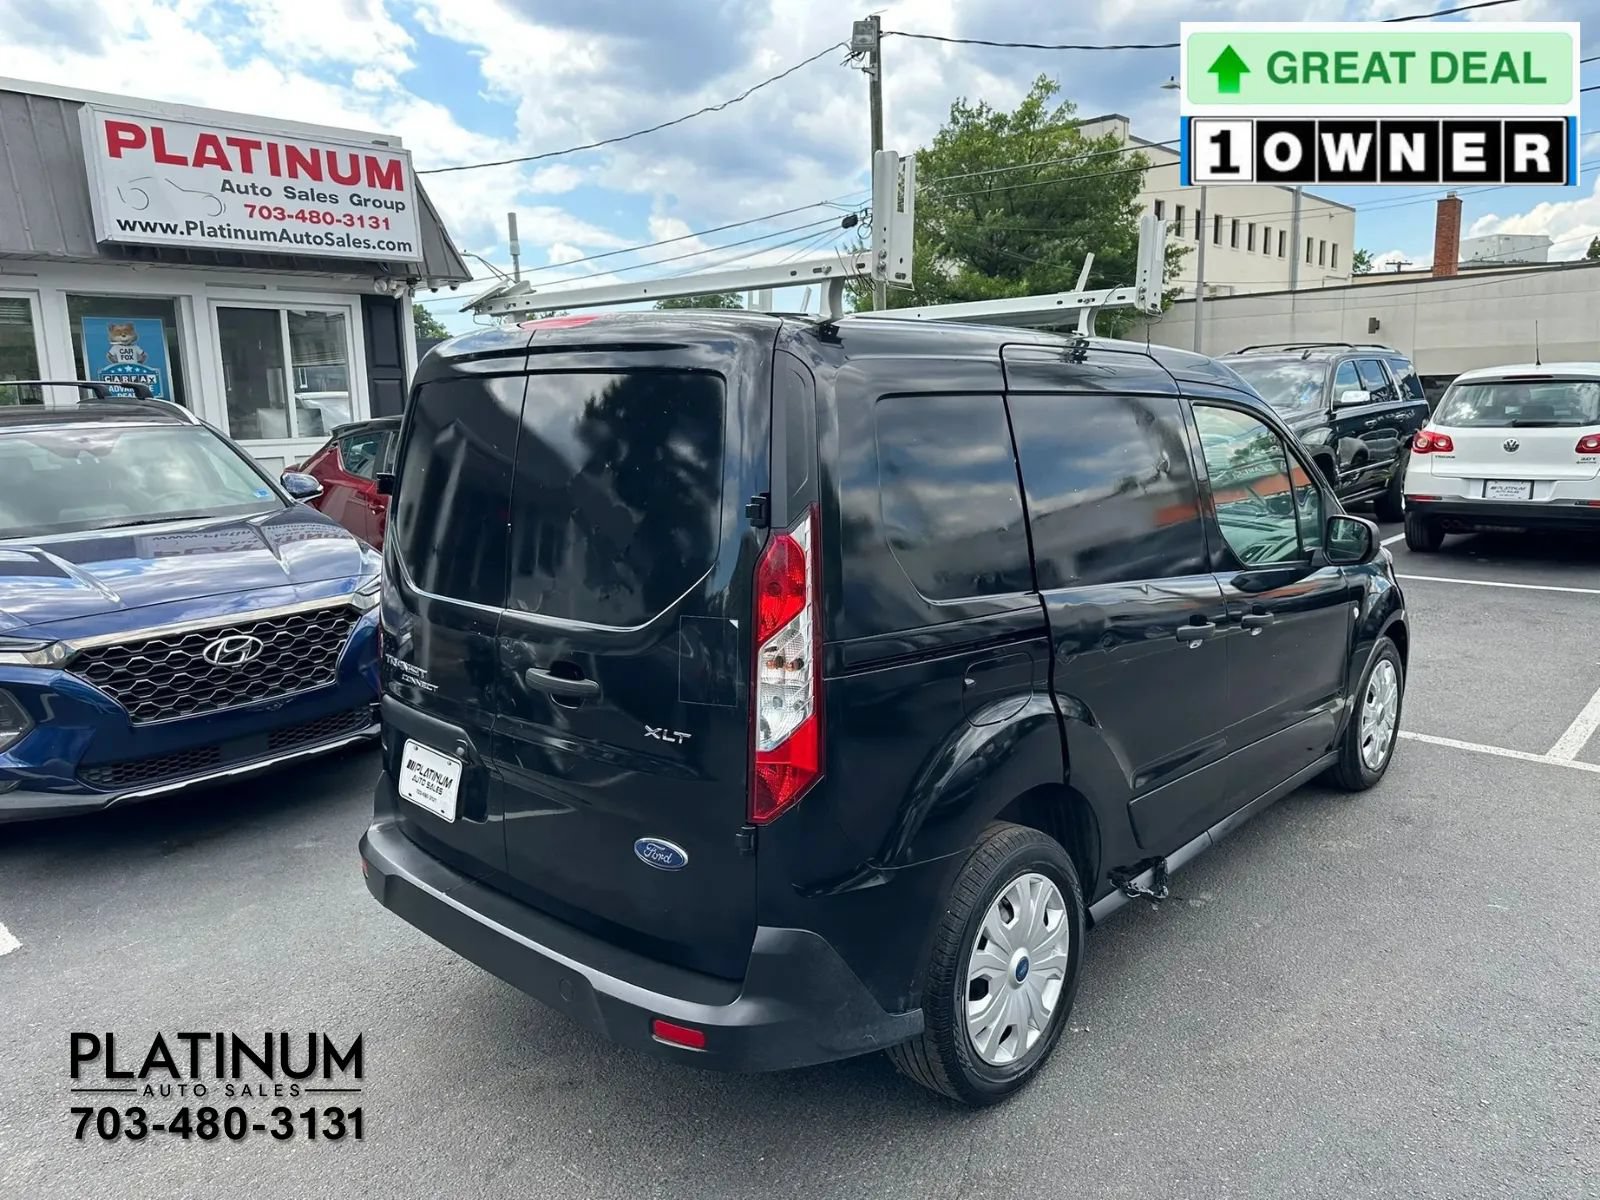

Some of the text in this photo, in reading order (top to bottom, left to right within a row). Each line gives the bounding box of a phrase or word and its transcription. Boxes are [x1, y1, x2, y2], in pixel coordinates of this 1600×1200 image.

[104, 119, 405, 191] PLATINUM
[220, 179, 406, 213] Auto Sales Group
[243, 203, 391, 231] 703-480-3131
[116, 217, 413, 253] www.PlatinumAutoSales.com
[104, 375, 157, 383] CARFAX
[644, 725, 692, 744] XLT
[412, 775, 427, 786] AUTO
[426, 781, 443, 795] SALES
[415, 763, 453, 789] PLATINUM
[643, 843, 673, 864] Ford
